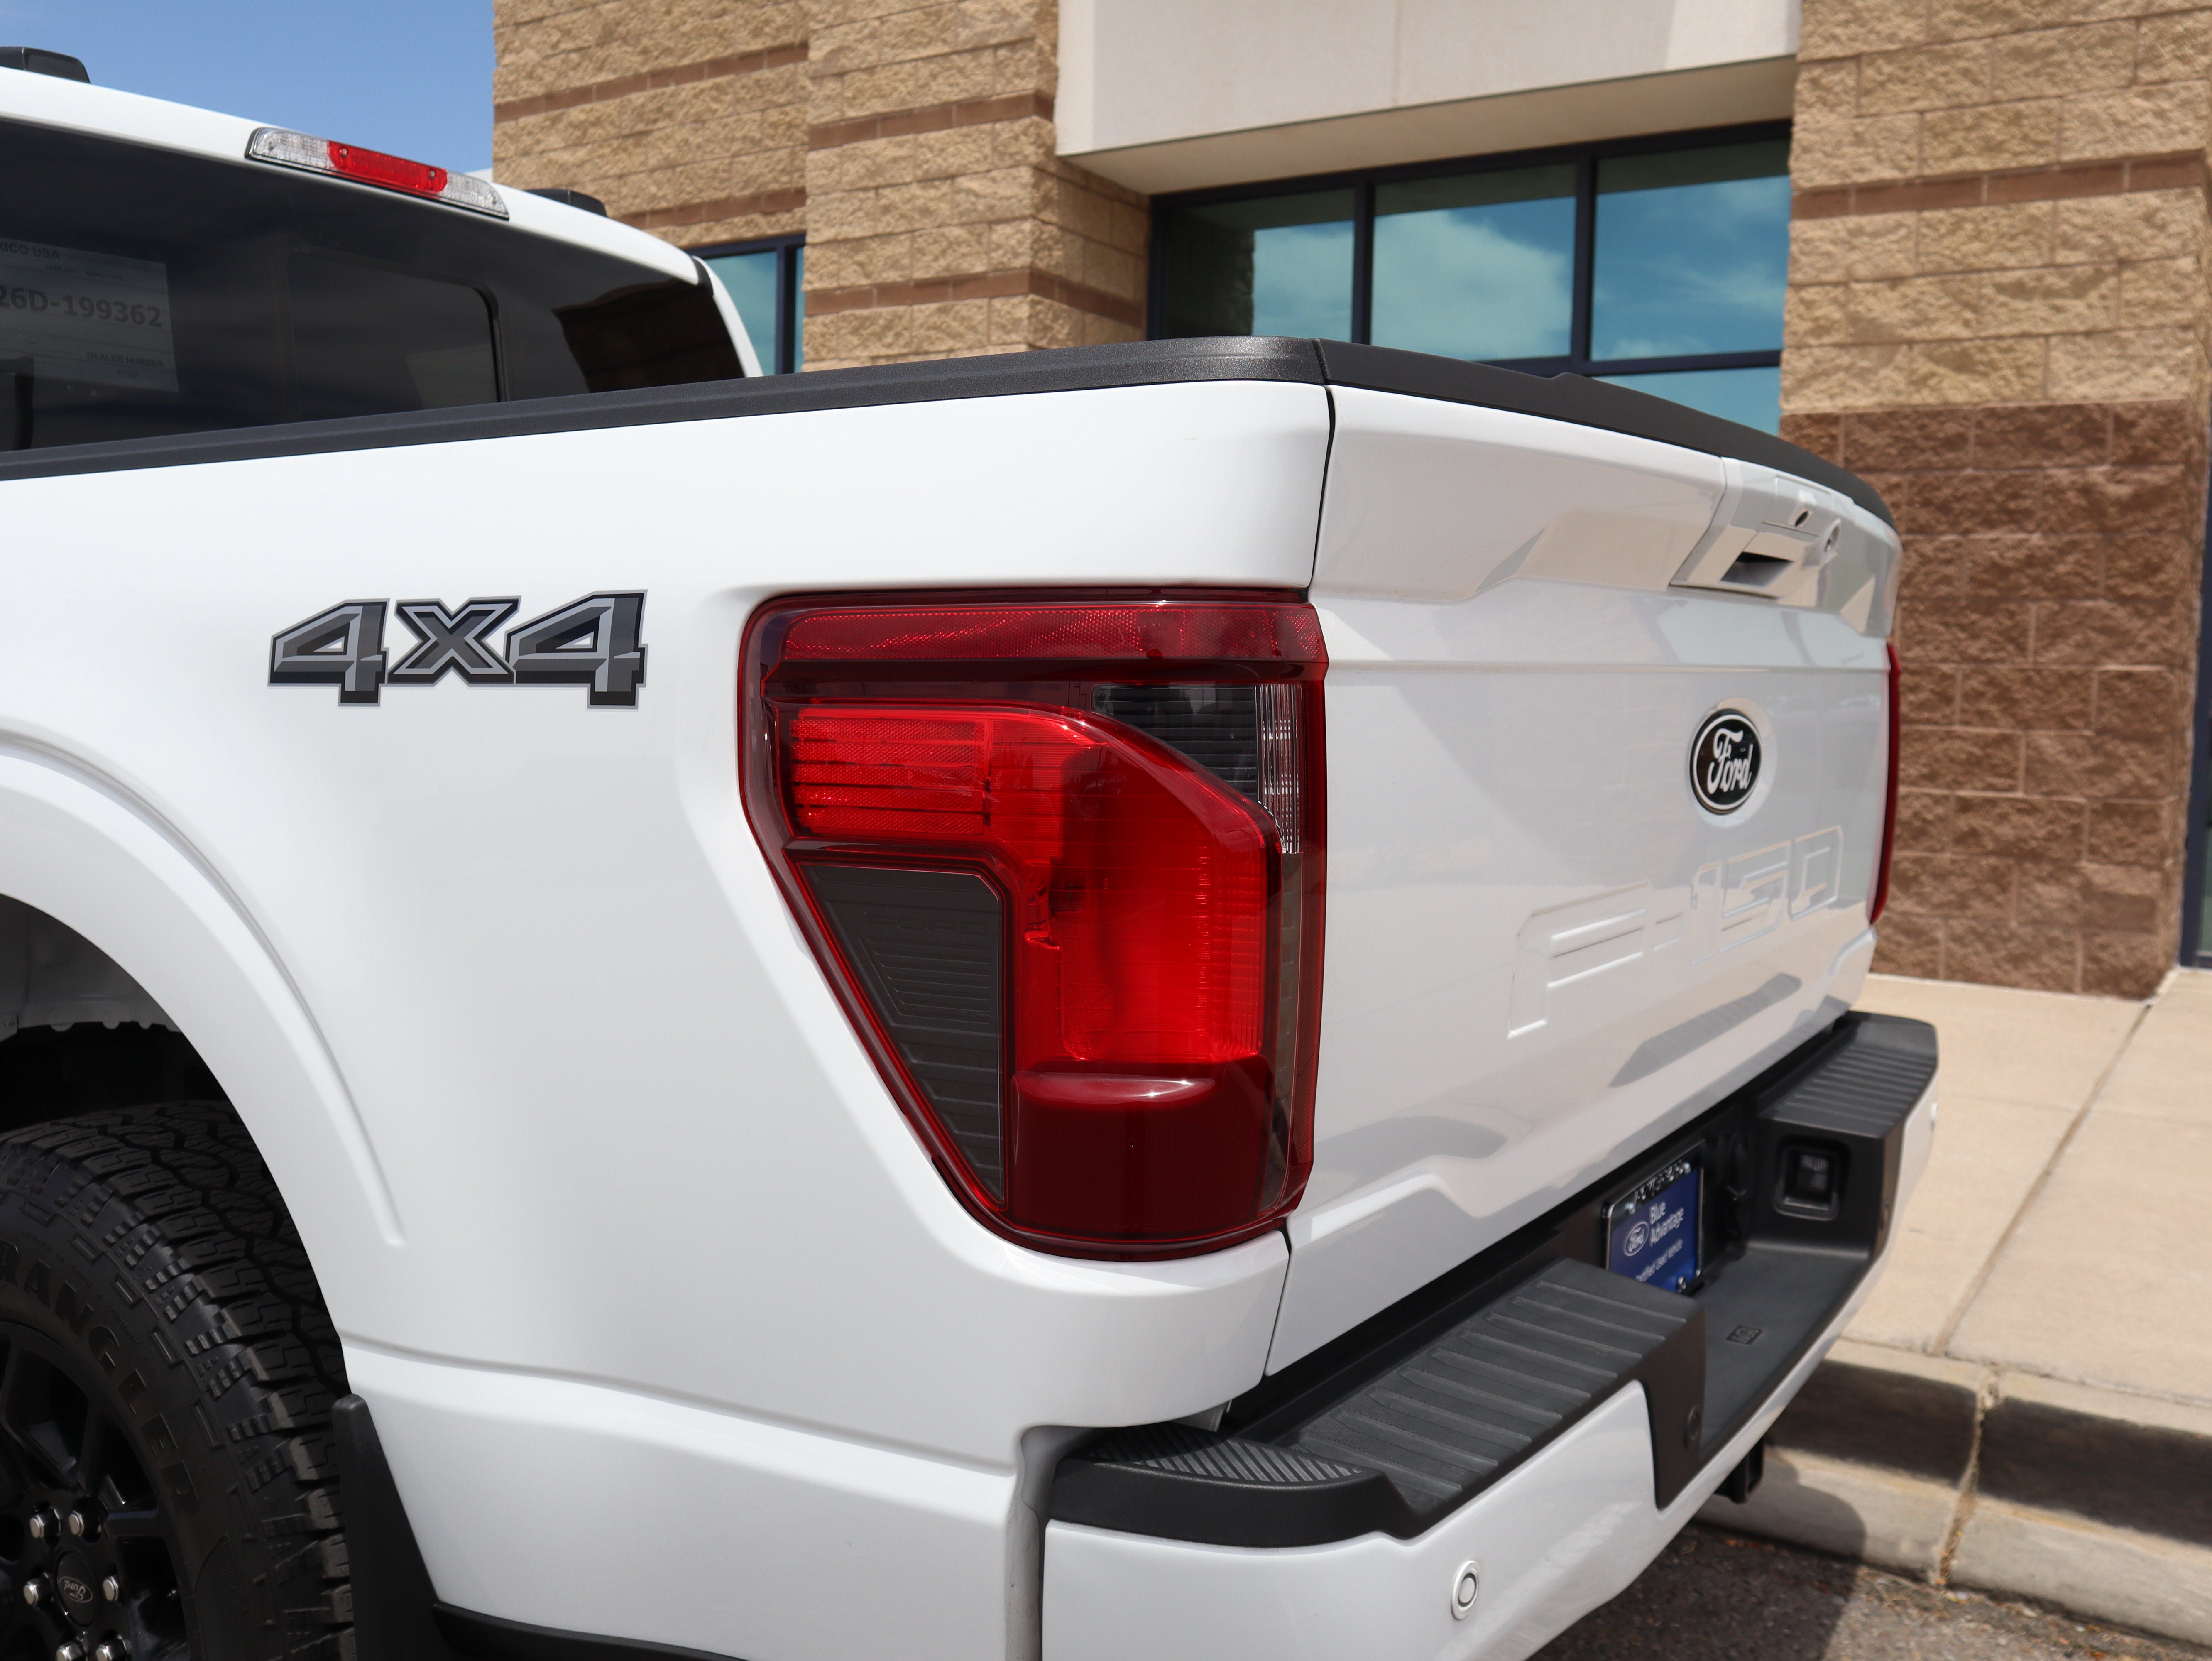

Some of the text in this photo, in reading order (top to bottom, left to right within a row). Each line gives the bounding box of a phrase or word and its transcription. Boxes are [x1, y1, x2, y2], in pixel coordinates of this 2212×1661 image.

[33, 246, 60, 260] USA
[0, 284, 162, 328] 26D-199362
[87, 351, 164, 368] DEALER NUMBER
[1706, 728, 1754, 794] Ford
[1508, 825, 1843, 1039] F-150
[1650, 1202, 1666, 1225] Blue
[1629, 1227, 1645, 1252] Ford
[1650, 1208, 1684, 1247] Advantage
[64, 1579, 86, 1600] Ford
